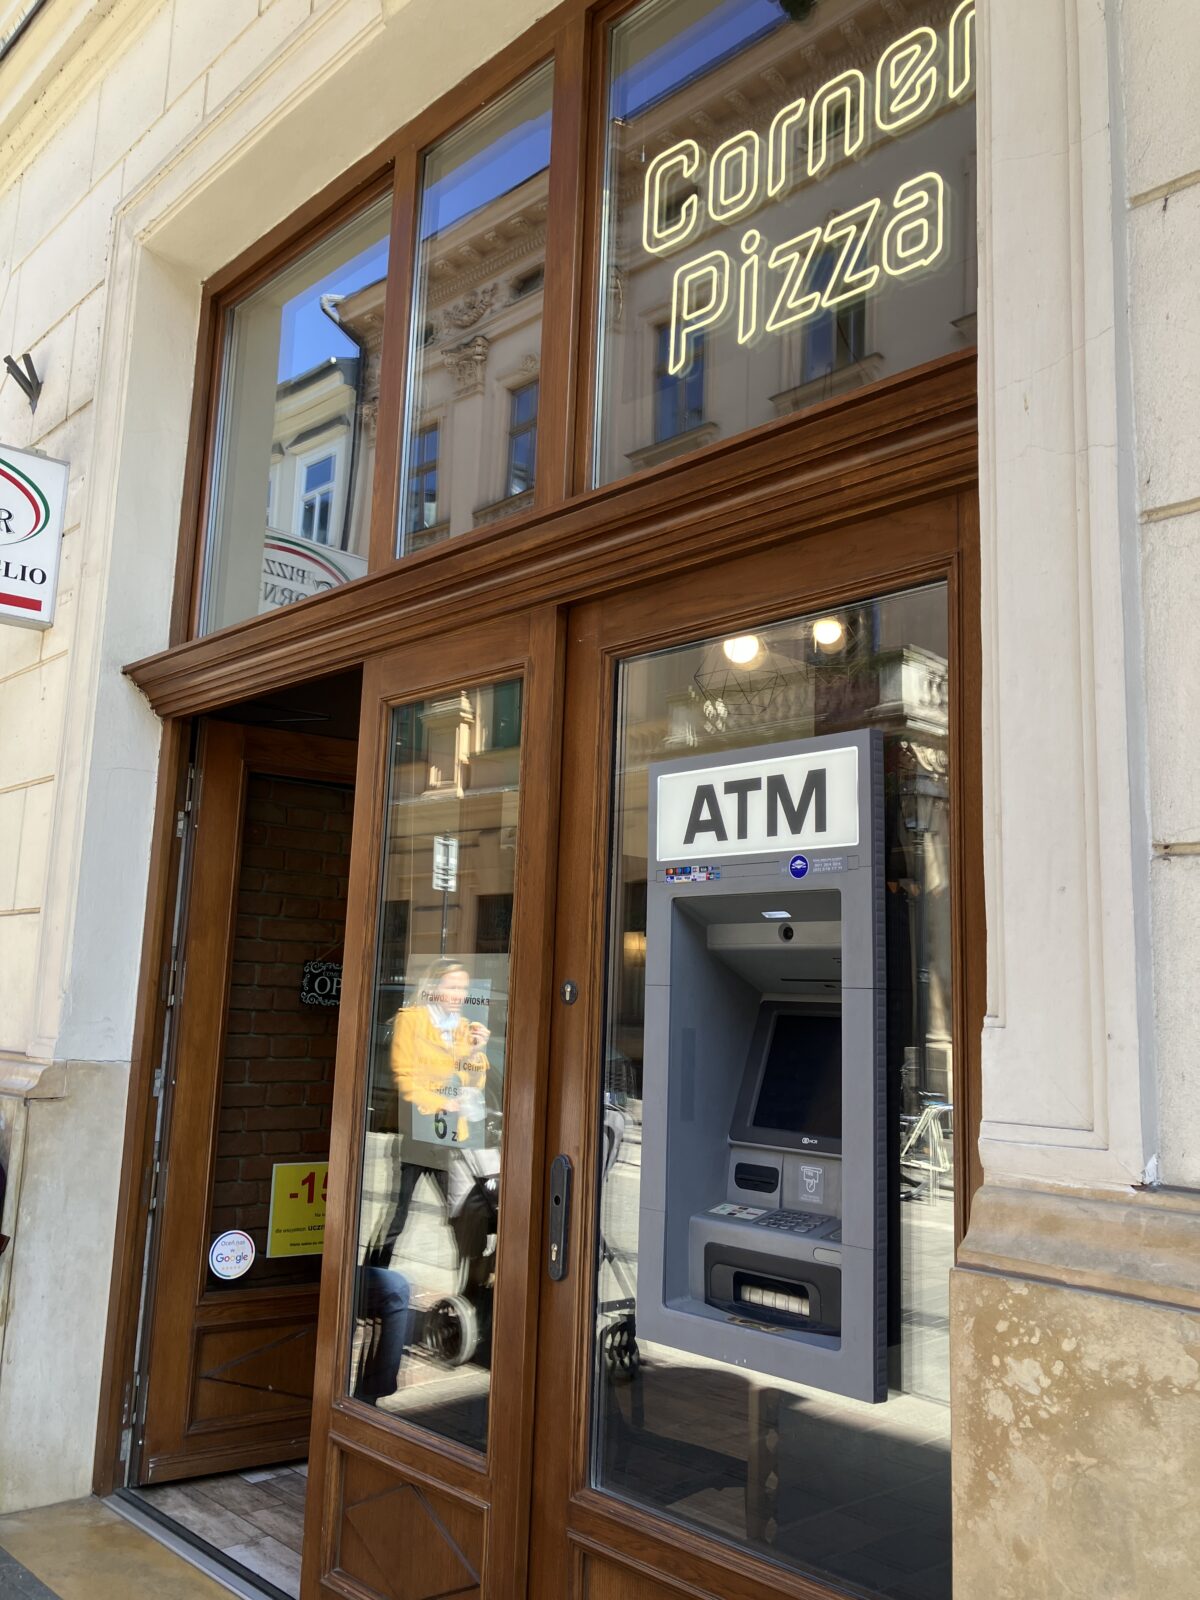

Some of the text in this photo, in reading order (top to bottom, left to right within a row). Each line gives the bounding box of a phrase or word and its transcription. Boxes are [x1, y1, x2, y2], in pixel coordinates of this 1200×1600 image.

[668, 171, 944, 376] Pizza
[0, 560, 47, 585] LIO
[683, 768, 826, 844] ATM
[435, 1108, 447, 1139] 6
[215, 1252, 249, 1264] Google
